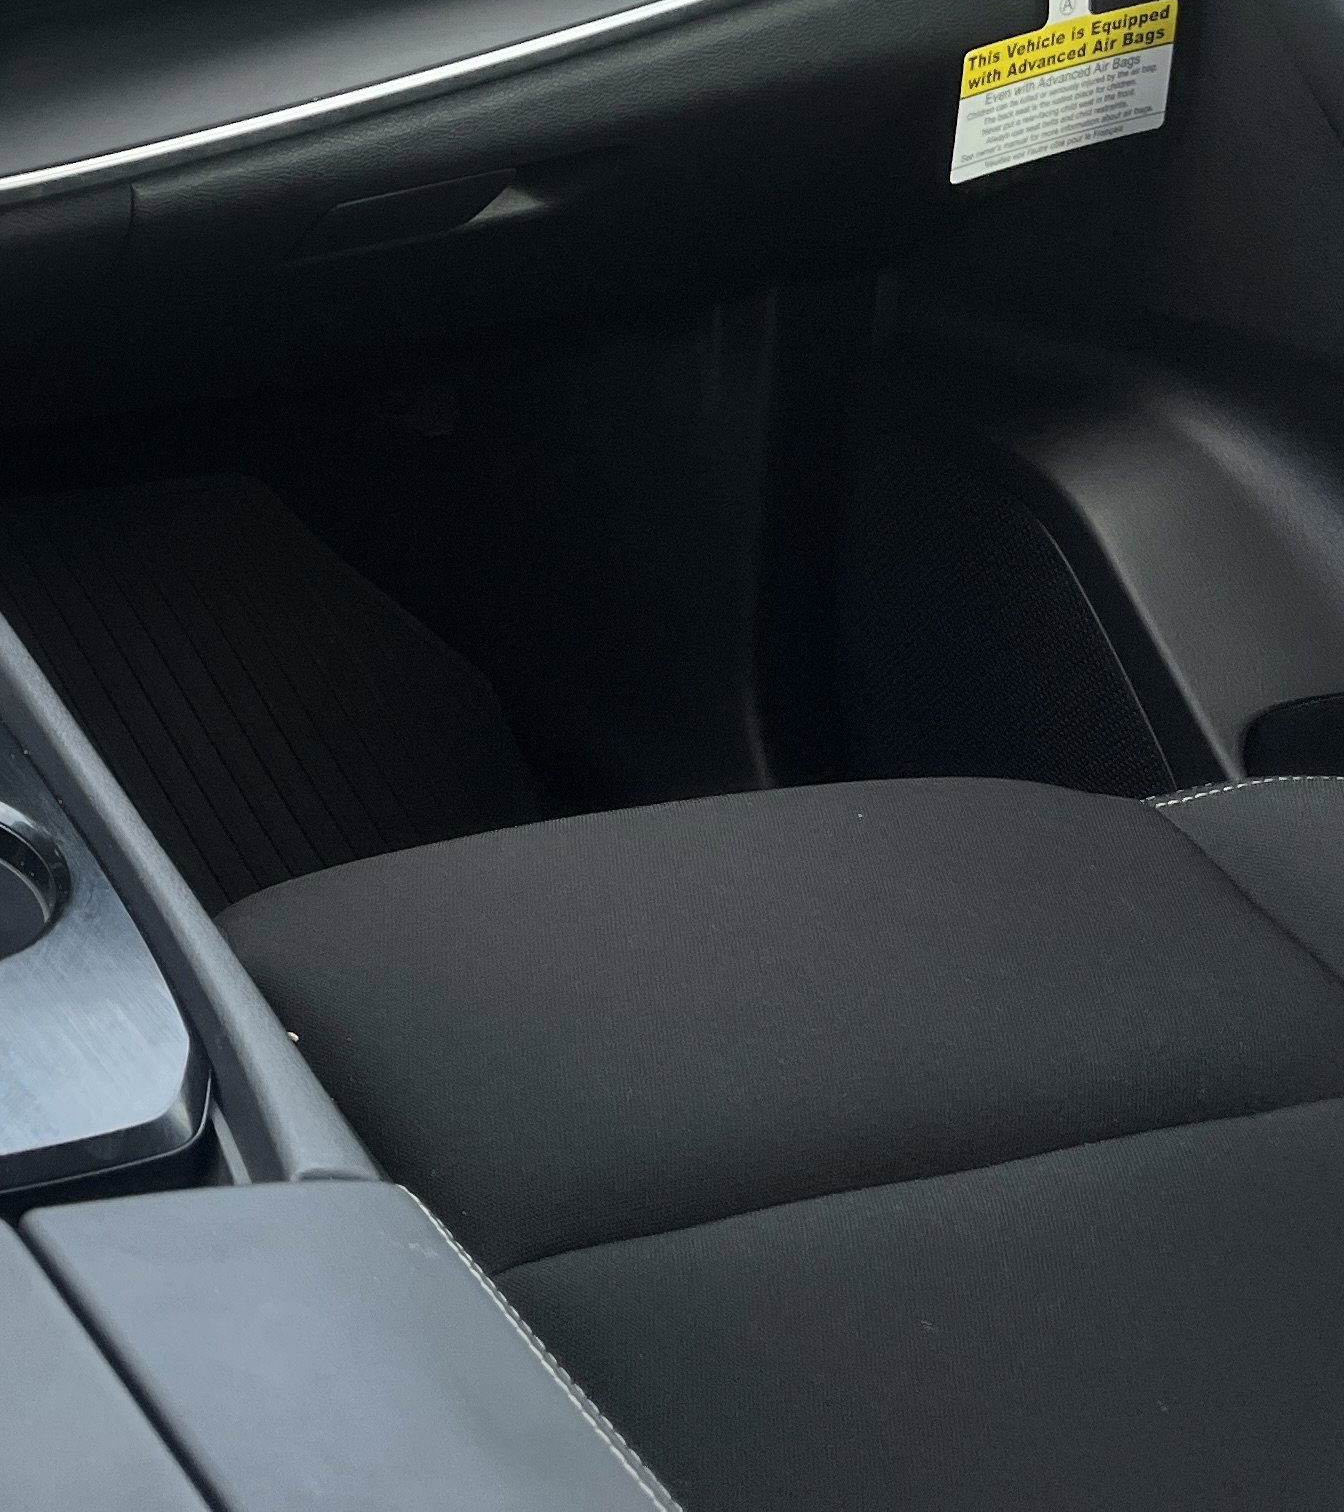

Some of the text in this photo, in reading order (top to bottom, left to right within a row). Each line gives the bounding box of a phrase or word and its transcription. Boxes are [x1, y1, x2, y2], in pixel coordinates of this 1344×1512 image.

[968, 5, 1170, 70] This Vehicle is Equipped
[969, 29, 1164, 89] with Advanced Air Bags
[985, 56, 1140, 104] Even with Advanced Air Bags
